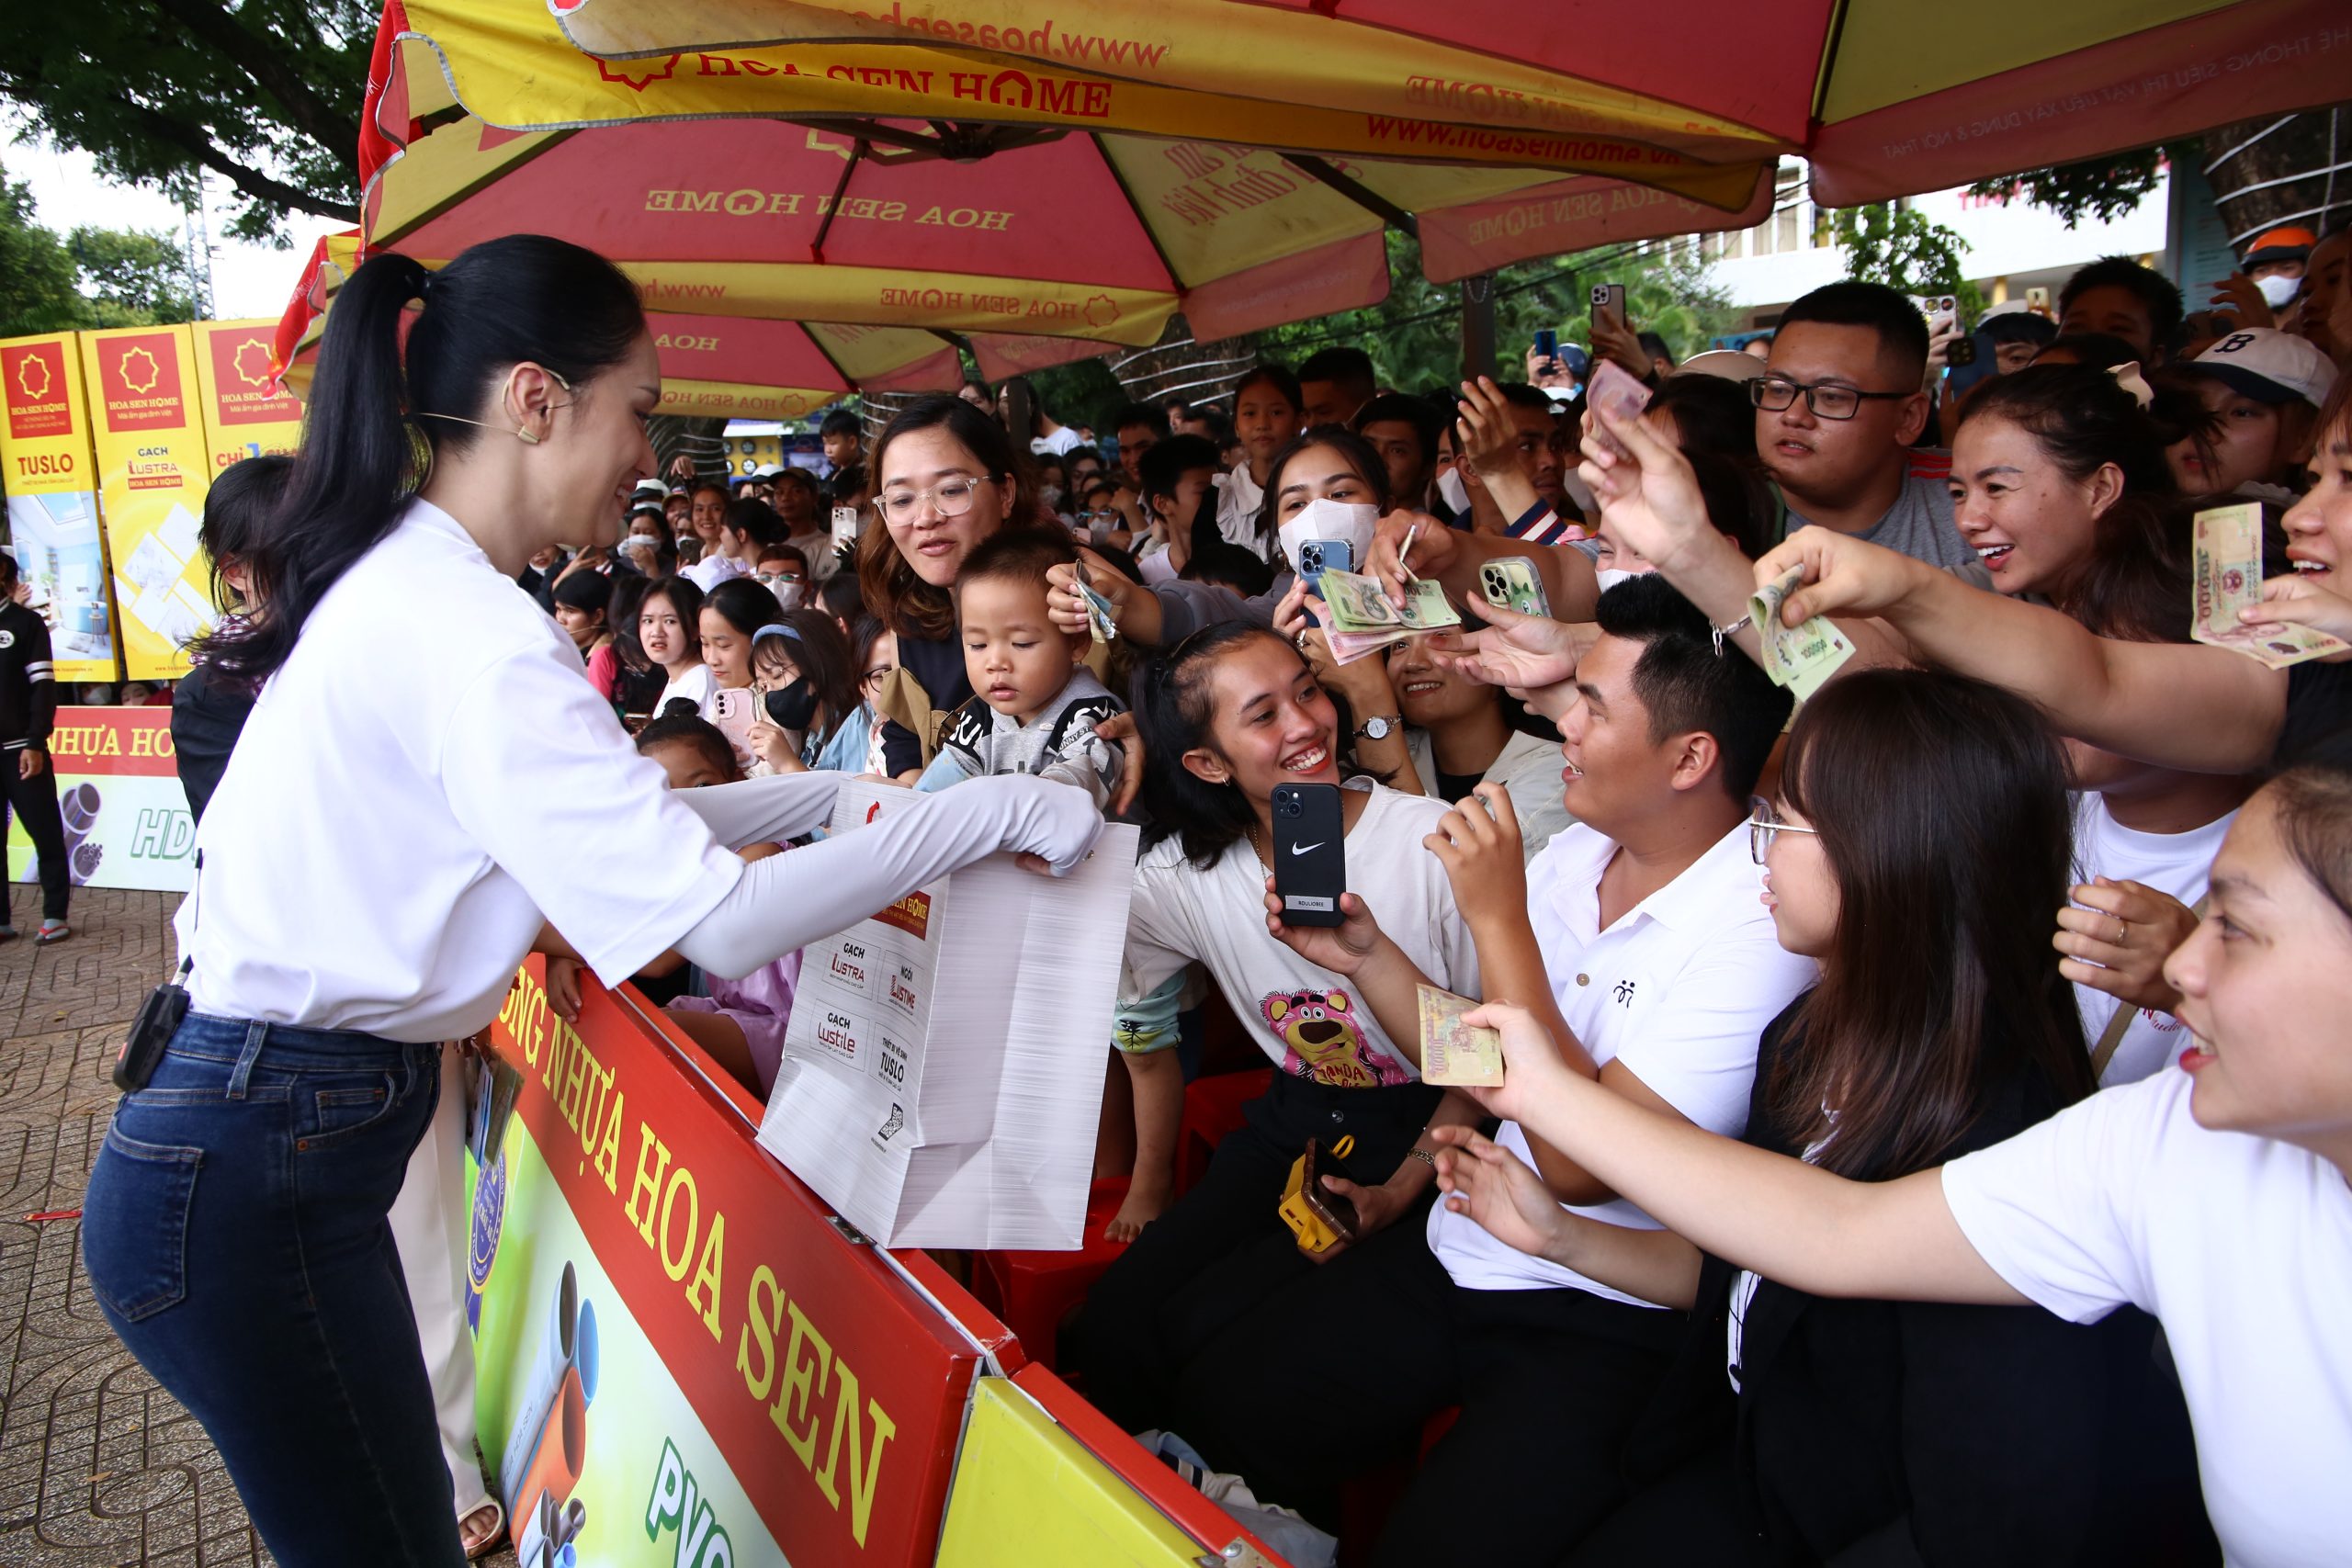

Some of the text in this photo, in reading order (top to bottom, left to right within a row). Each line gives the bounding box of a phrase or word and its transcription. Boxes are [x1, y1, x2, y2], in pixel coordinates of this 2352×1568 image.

[949, 69, 1113, 118] HOME
[2214, 333, 2256, 353] B
[108, 397, 178, 411] HOA SEN HOME
[221, 393, 243, 403] HOA
[243, 392, 263, 402] SEN
[17, 453, 74, 477] TUSLO
[129, 728, 176, 759] HO
[908, 897, 929, 920] HOME
[843, 942, 865, 959] GẠCH
[828, 1012, 851, 1030] GẠCH
[880, 1052, 905, 1083] TUSLO
[542, 1012, 625, 1197] NHỰA
[624, 1121, 727, 1345] HOA
[735, 1264, 897, 1551] SEN
